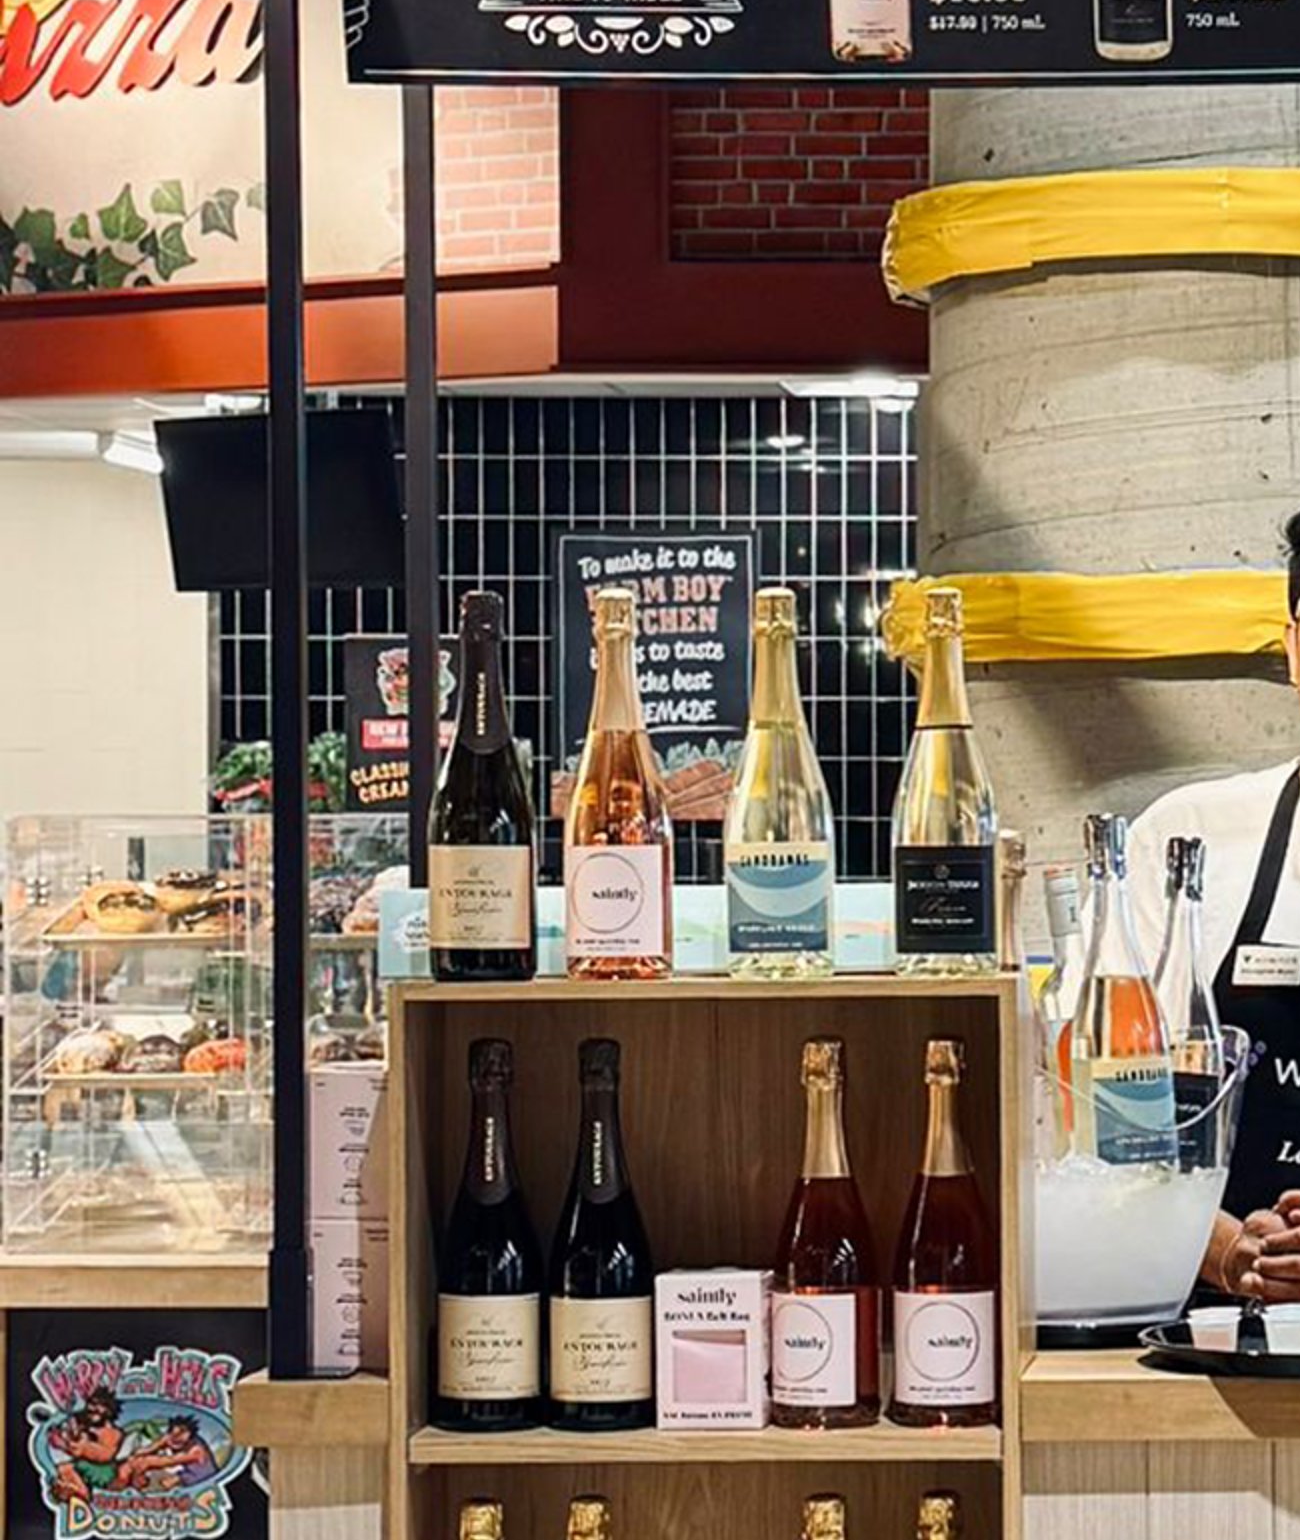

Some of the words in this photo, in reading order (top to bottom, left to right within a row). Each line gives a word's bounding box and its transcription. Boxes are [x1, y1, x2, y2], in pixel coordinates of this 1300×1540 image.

[992, 15, 1018, 31] 750
[1185, 13, 1213, 29] 750
[577, 556, 601, 580] To
[604, 548, 655, 574] make
[655, 545, 675, 569] it
[677, 547, 699, 569] to
[702, 545, 737, 570] the
[672, 574, 726, 602] BOY
[649, 641, 671, 662] to
[673, 640, 726, 662] taste
[671, 668, 714, 692] best
[677, 1286, 737, 1307] saintly
